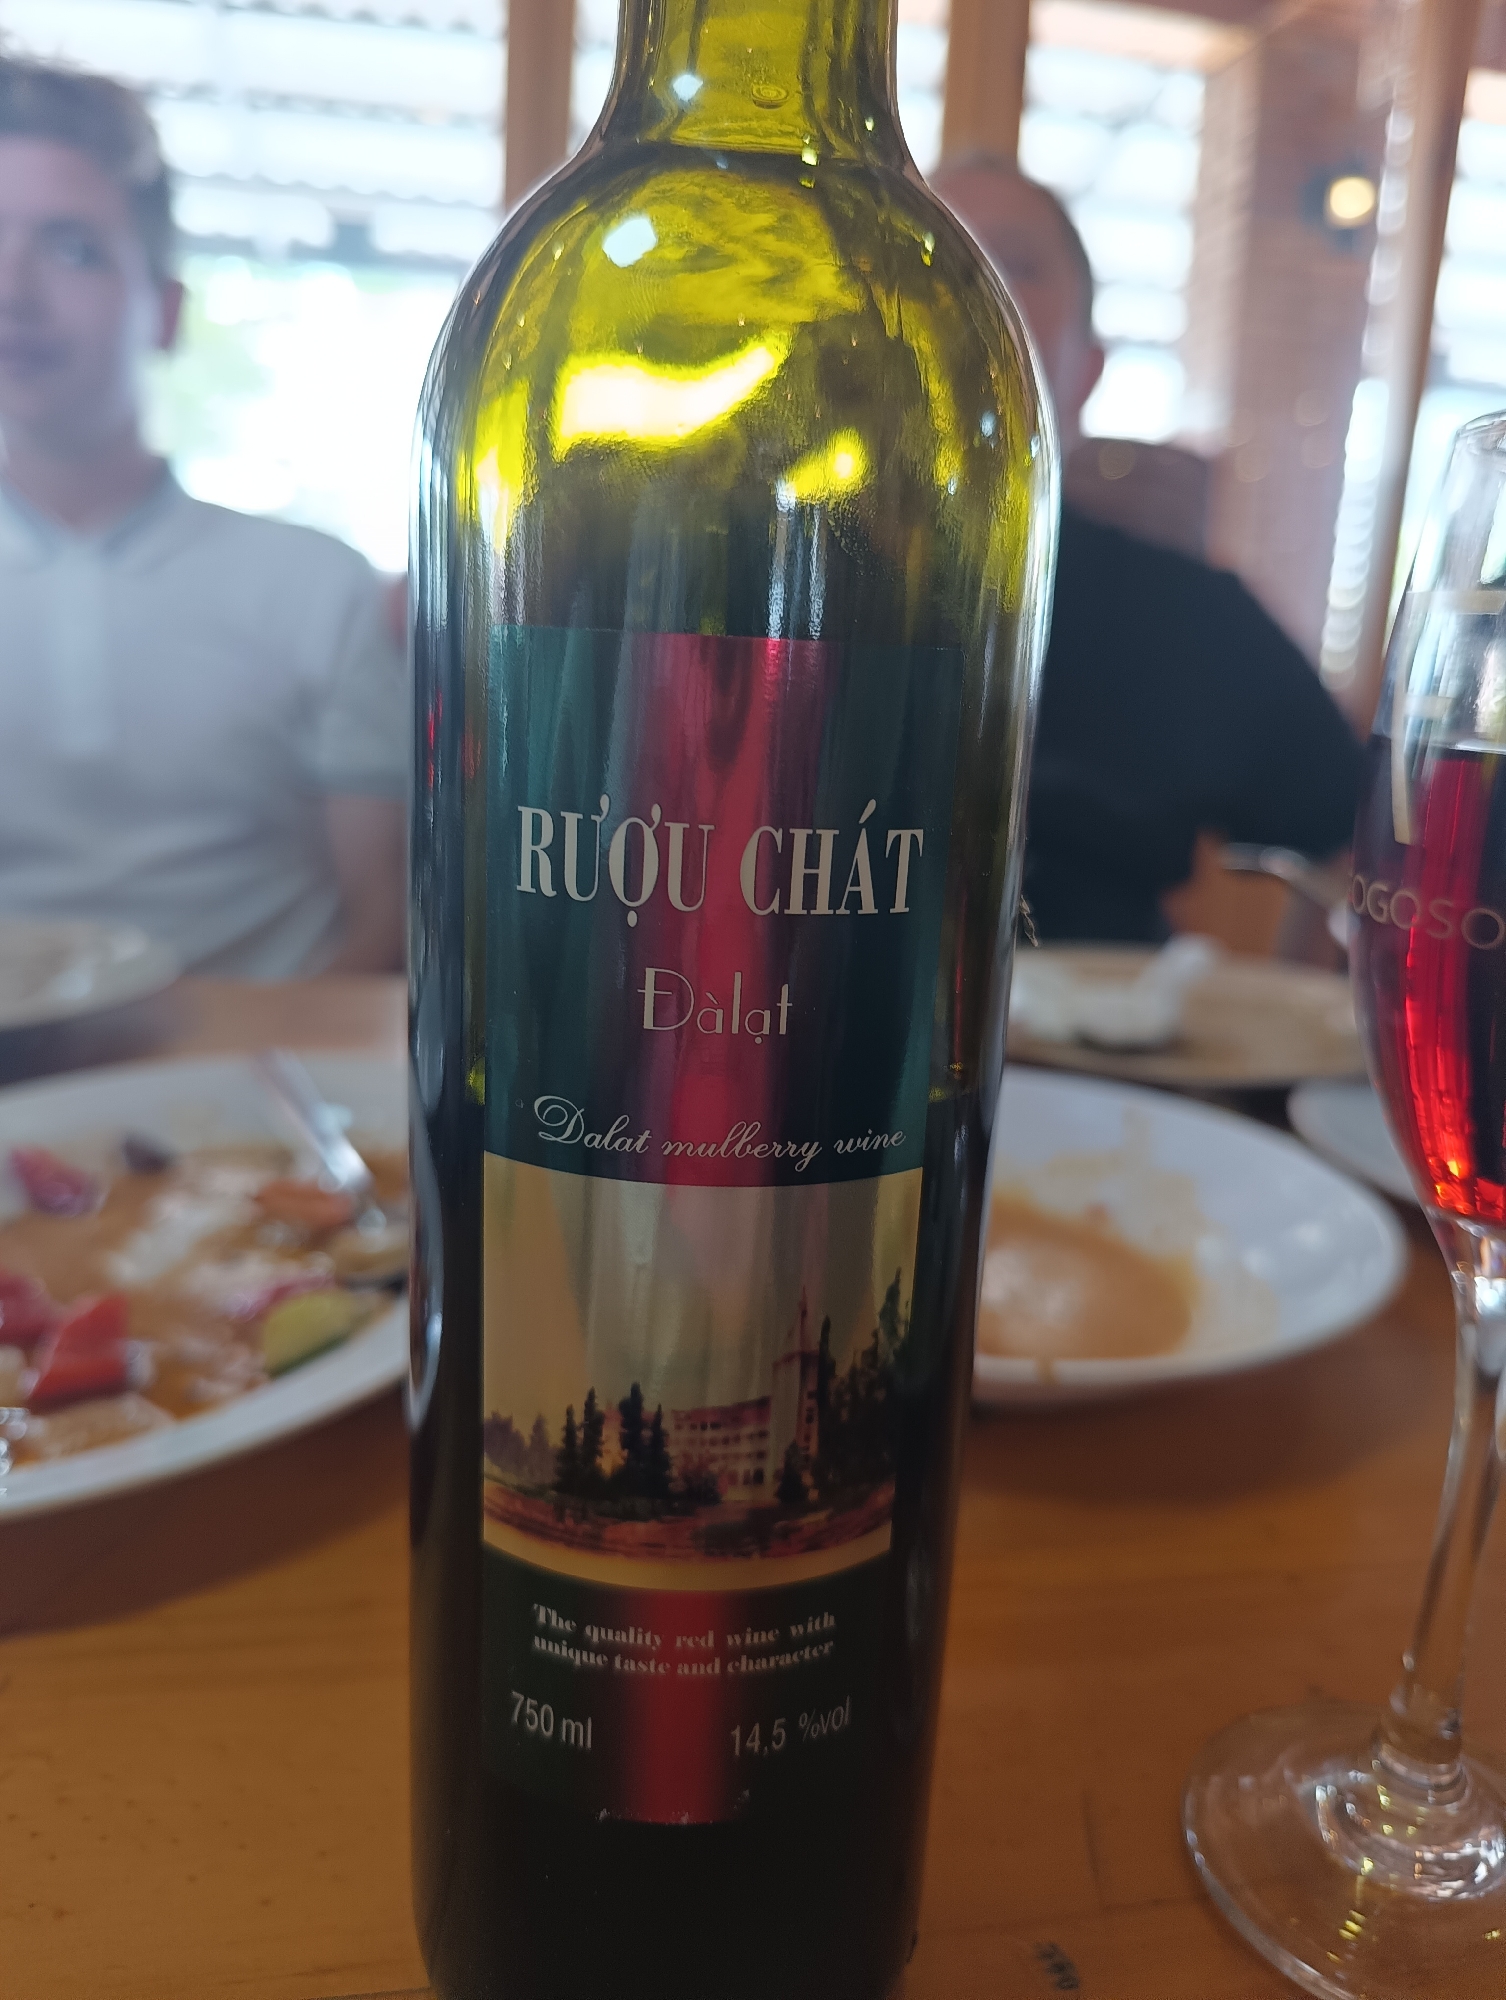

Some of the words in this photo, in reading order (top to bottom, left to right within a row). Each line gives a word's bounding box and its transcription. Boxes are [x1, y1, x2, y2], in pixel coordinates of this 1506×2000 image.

[739, 799, 924, 916] CHÁT
[533, 1095, 651, 1154] Dalat
[661, 1121, 823, 1172] mulberry
[833, 1127, 906, 1155] wine
[533, 1603, 577, 1631] The
[585, 1621, 662, 1651] quality
[675, 1630, 714, 1648] red
[726, 1626, 780, 1647] wine
[789, 1611, 836, 1638] with
[534, 1635, 608, 1666] unique
[614, 1653, 671, 1675] taste
[676, 1656, 721, 1675] and
[727, 1640, 834, 1674] character
[511, 1690, 554, 1736] 750
[561, 1716, 592, 1750] ml
[731, 1716, 786, 1757] 14,5
[799, 1695, 851, 1742] %vol
